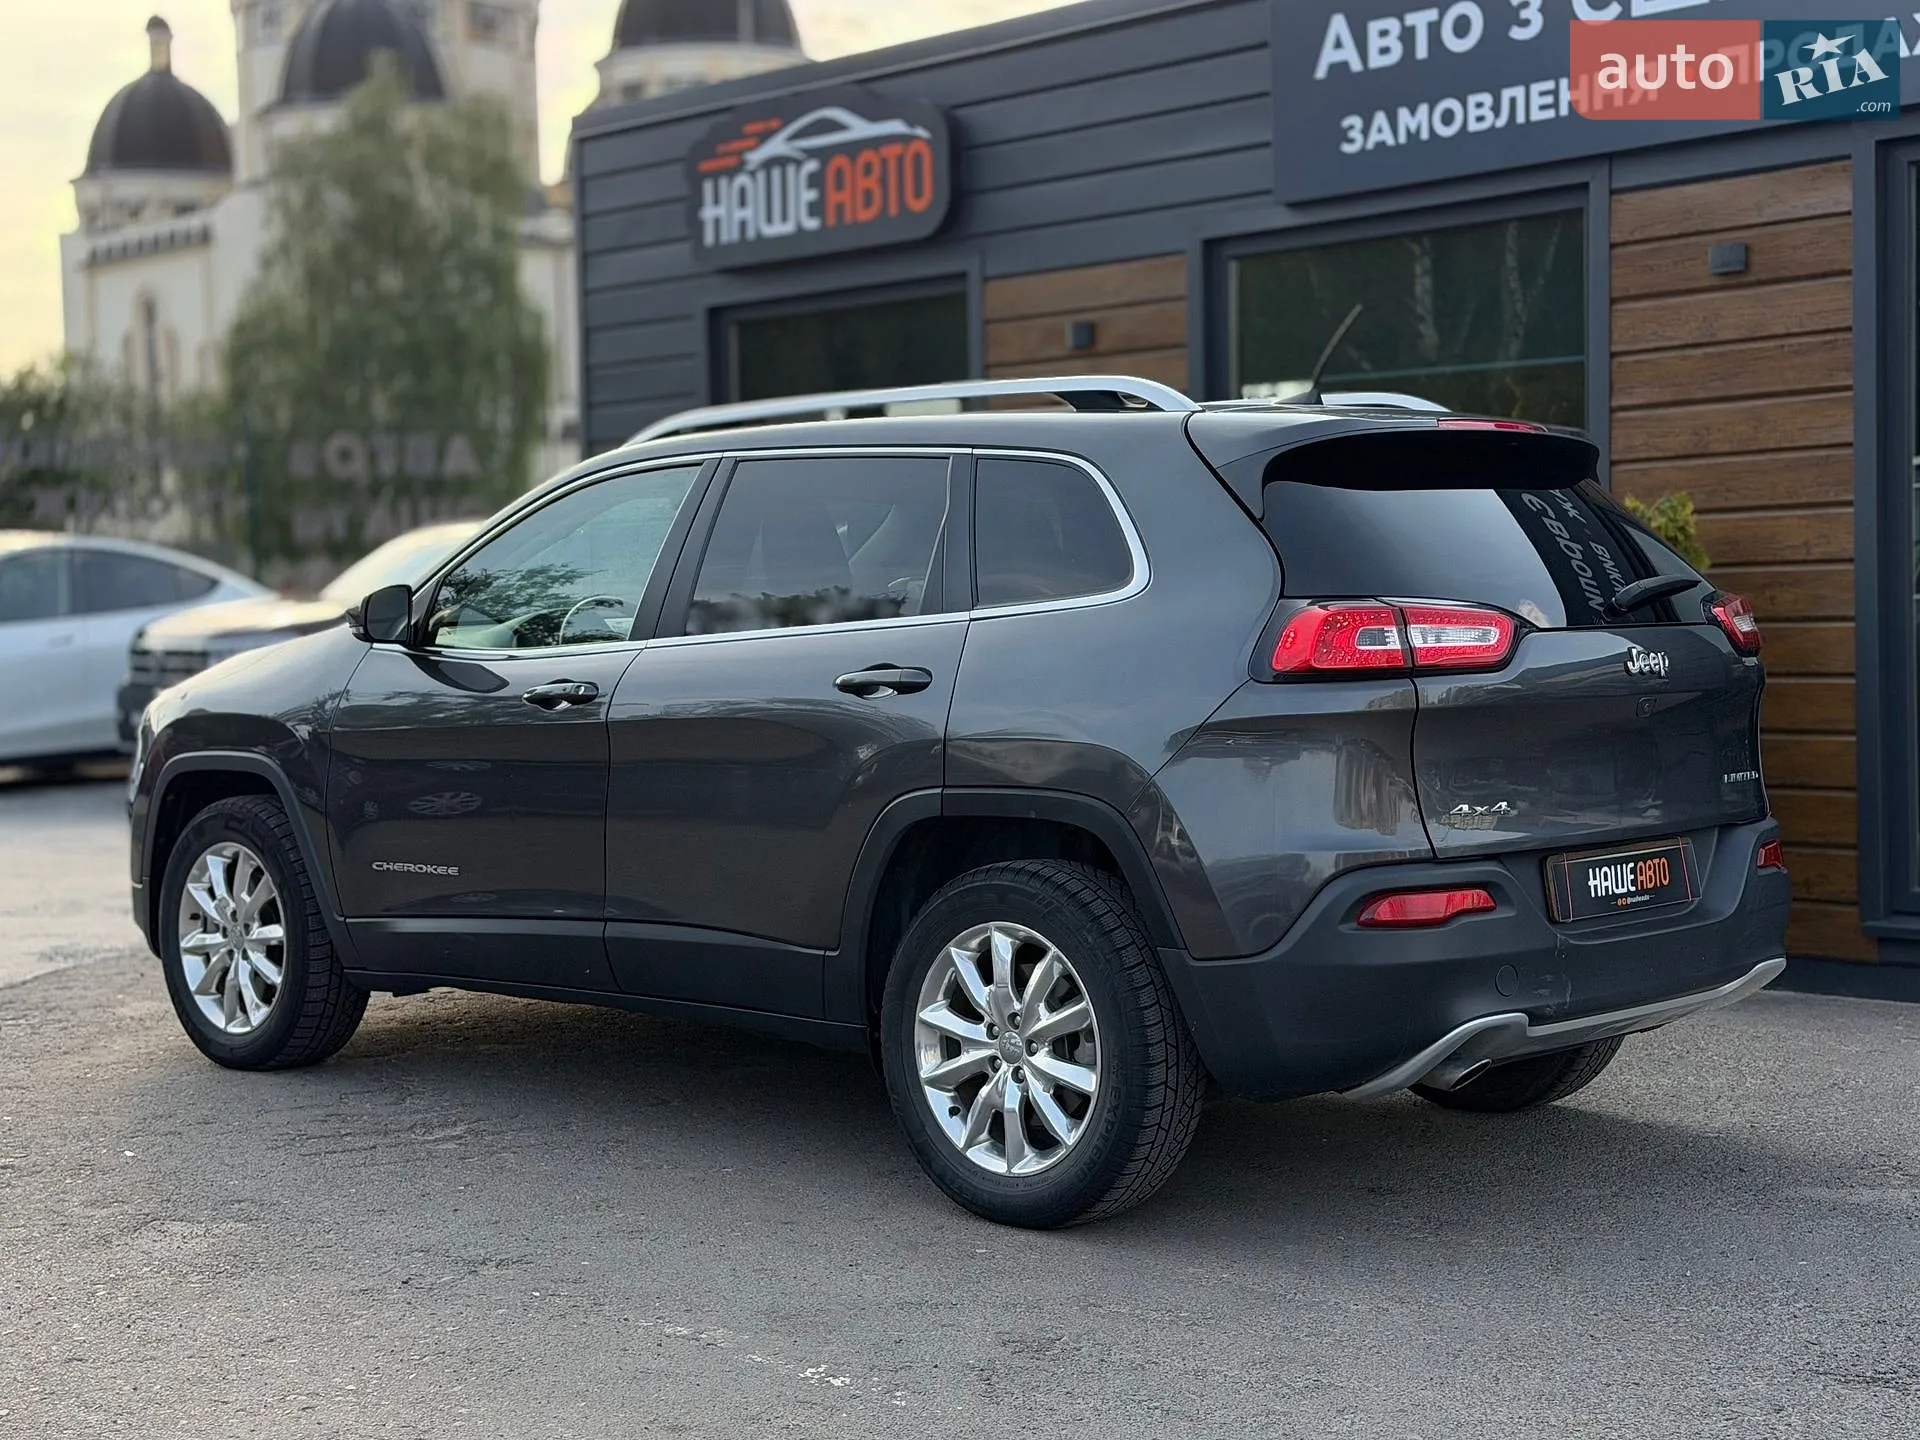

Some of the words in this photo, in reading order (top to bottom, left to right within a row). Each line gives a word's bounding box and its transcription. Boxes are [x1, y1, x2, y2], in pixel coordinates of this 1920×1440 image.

[1716, 12, 1920, 86] ПРОДА
[699, 158, 823, 248] НАШЕ
[825, 138, 933, 228] АВТО
[1626, 647, 1669, 677] Jeep
[1449, 801, 1511, 817] 4x4
[371, 861, 460, 876] CHEROKEE
[1588, 862, 1636, 898] НАШЕ
[1637, 857, 1670, 891] АВТО
